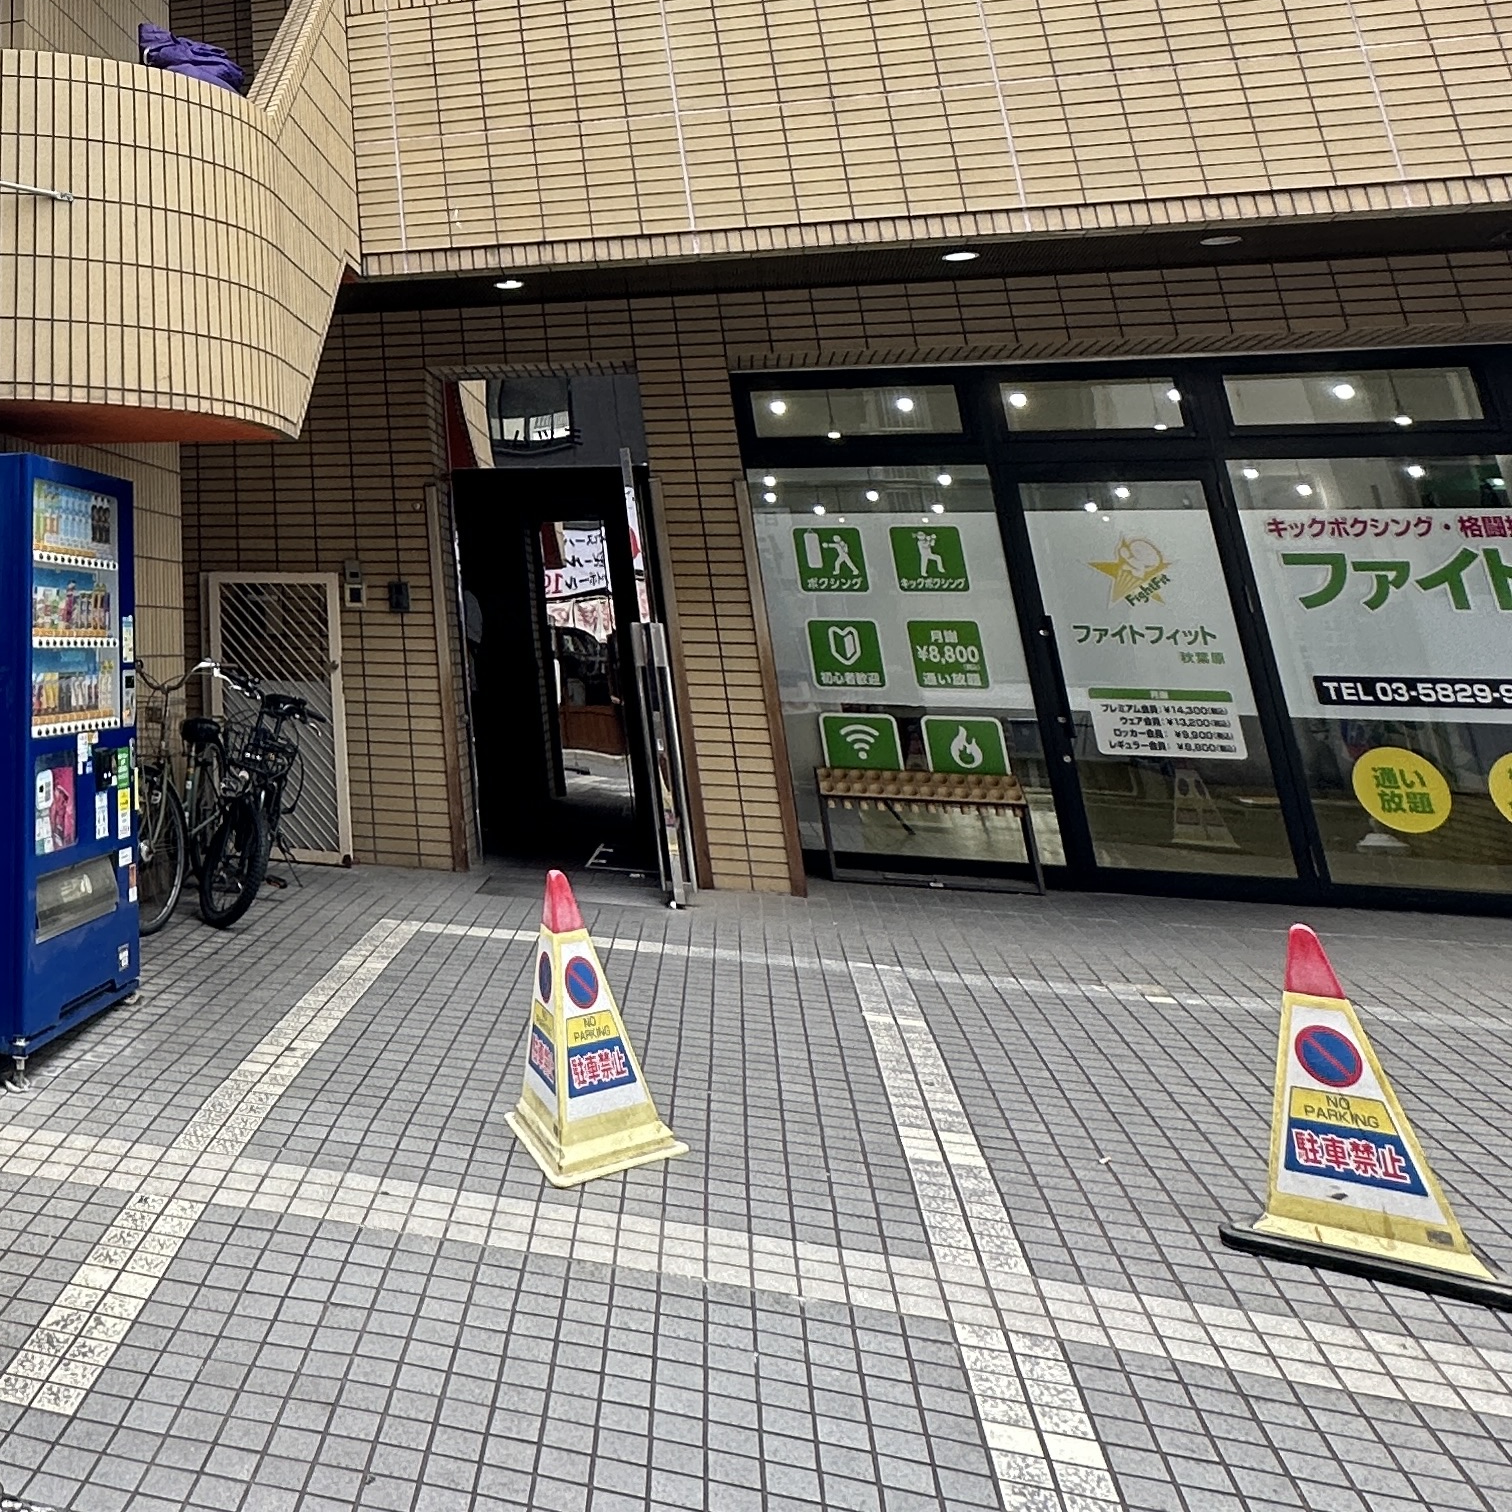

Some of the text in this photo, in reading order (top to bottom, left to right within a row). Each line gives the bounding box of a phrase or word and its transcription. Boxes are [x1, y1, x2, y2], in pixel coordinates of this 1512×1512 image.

[807, 577, 863, 589] ボクシング
[900, 577, 966, 589] キックボクシング
[1124, 574, 1171, 607] FightFit
[1072, 624, 1217, 646] ファイトフィット
[916, 645, 980, 664] ¥8,800
[820, 671, 882, 685] 初心者歓迎
[923, 672, 982, 686] 通い放題
[1322, 682, 1512, 704] TEL 03-5829-9
[1372, 766, 1427, 789] 通い
[1378, 790, 1436, 814] 放題
[583, 1016, 597, 1028] NO
[573, 1025, 611, 1043] PARKING
[570, 1047, 629, 1088] 駐車禁止
[1325, 1093, 1351, 1110] NO
[1303, 1104, 1380, 1128] PARKING
[1292, 1128, 1411, 1185] 駐車禁止
